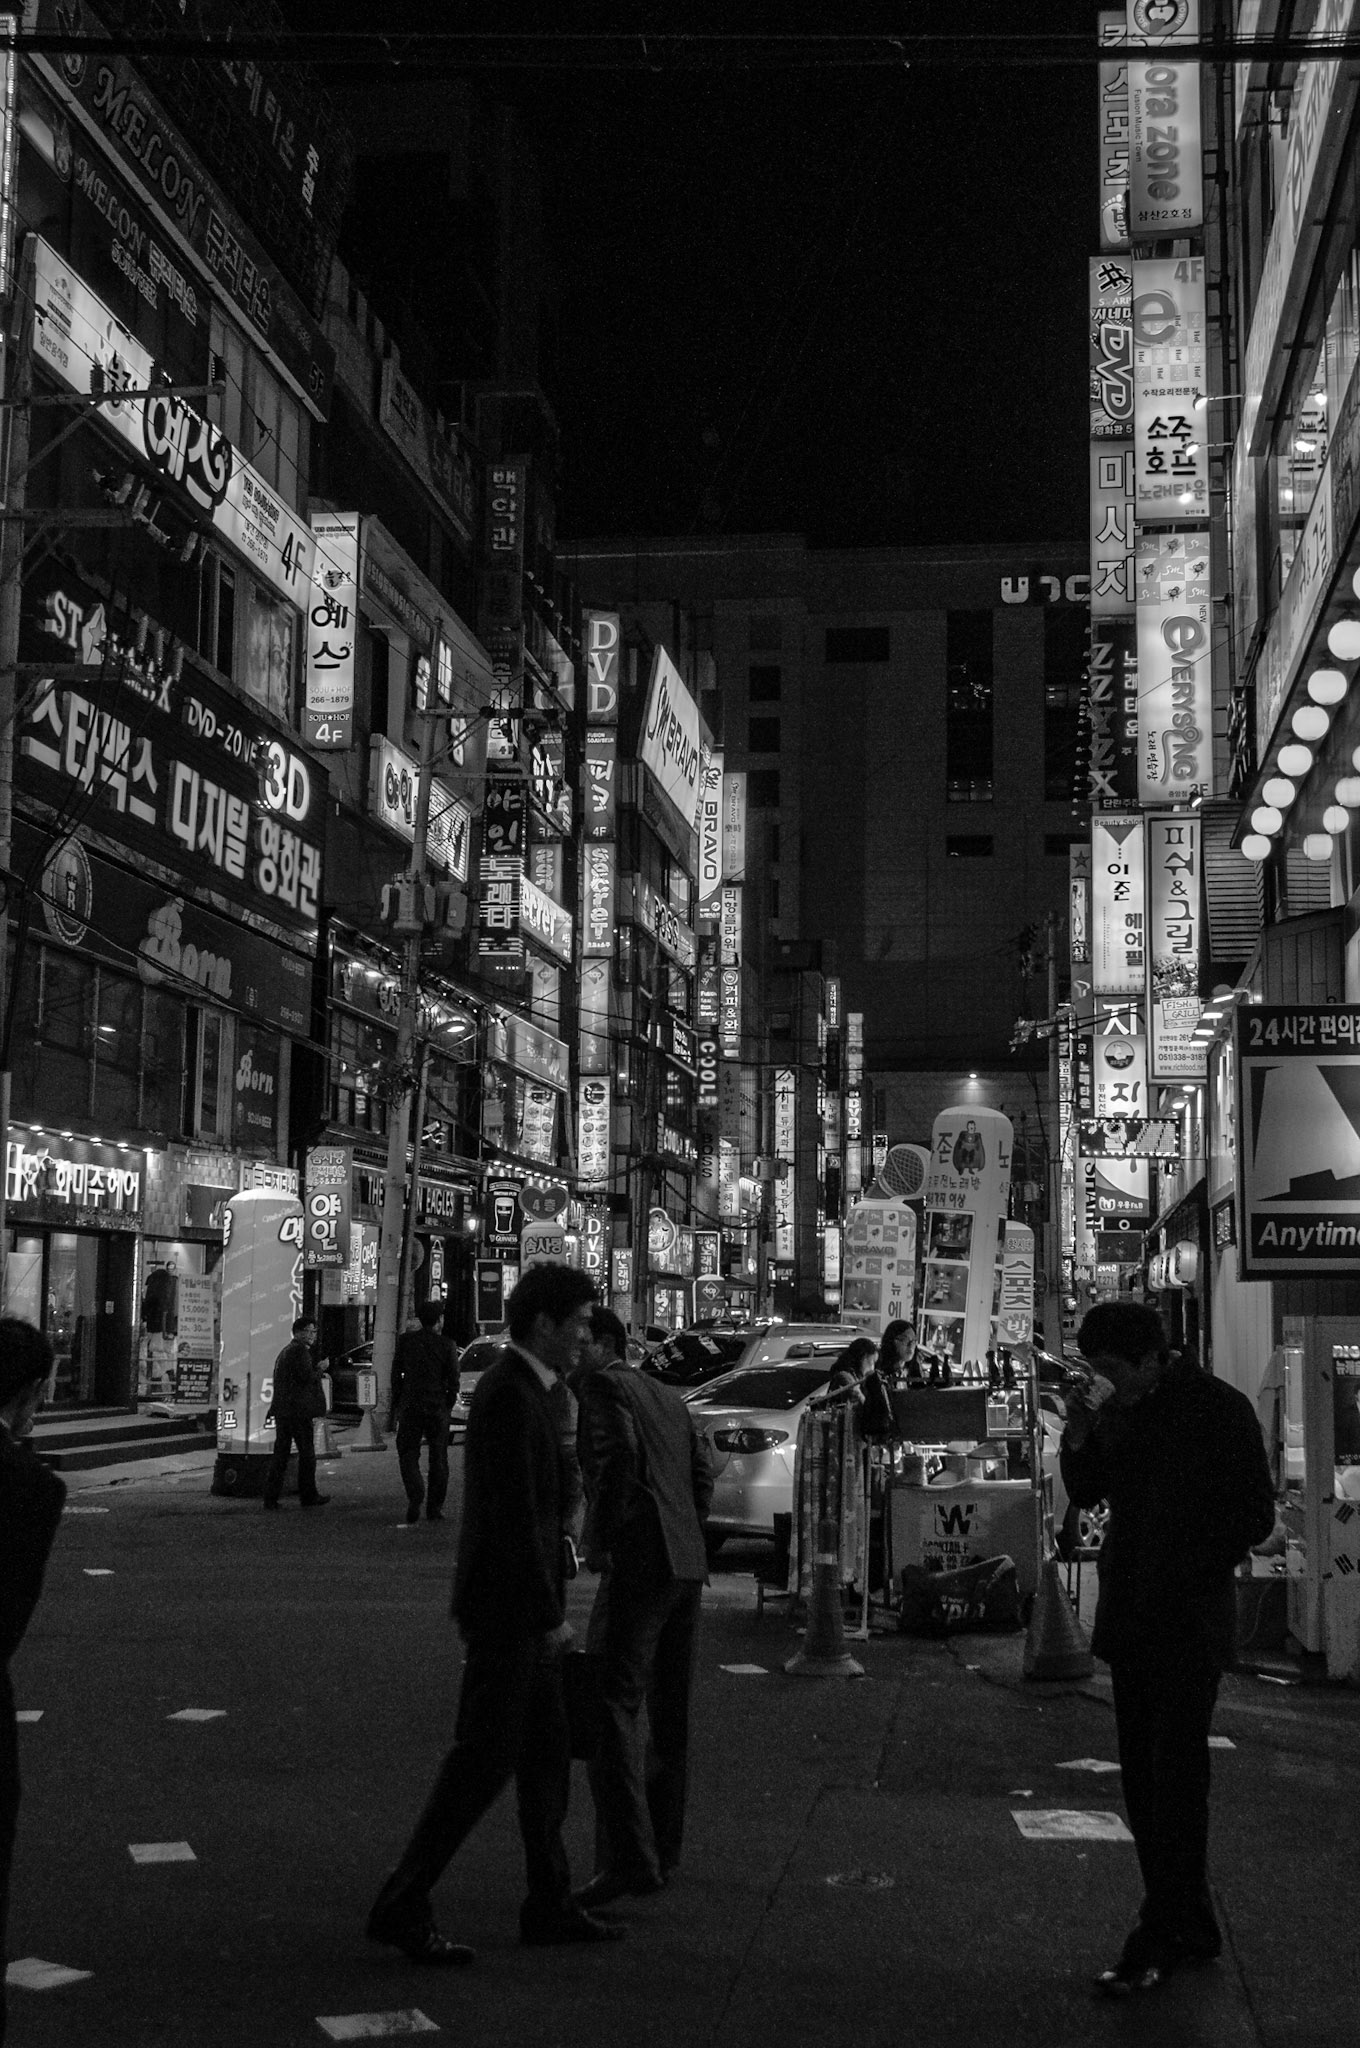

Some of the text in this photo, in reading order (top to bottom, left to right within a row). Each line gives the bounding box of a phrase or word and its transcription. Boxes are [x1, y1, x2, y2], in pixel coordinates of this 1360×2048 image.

[1134, 89, 1142, 115] Fusion
[1134, 116, 1143, 140] Music
[94, 66, 206, 240] MELON
[1146, 125, 1181, 201] zone
[76, 157, 146, 260] MELON
[1137, 209, 1192, 221] 삼산2호점
[1096, 323, 1134, 421] DVD
[1147, 415, 1193, 442] 소주
[1145, 447, 1197, 476] 호프
[1138, 480, 1206, 502] 노래타운
[281, 532, 307, 587] 4F
[1199, 605, 1207, 623] NEW
[310, 604, 352, 670] 예스
[590, 620, 618, 713] DVD
[310, 696, 350, 704] 266-1879
[315, 724, 343, 743] 4F
[264, 742, 310, 822] 3D
[592, 827, 607, 836] 4F
[703, 801, 718, 881] BRAVO
[1250, 1015, 1316, 1047] 24시간
[426, 1186, 455, 1217] EAGLES
[310, 1194, 342, 1251] 야인
[586, 1219, 602, 1269] DVD
[223, 1378, 238, 1402] 5F
